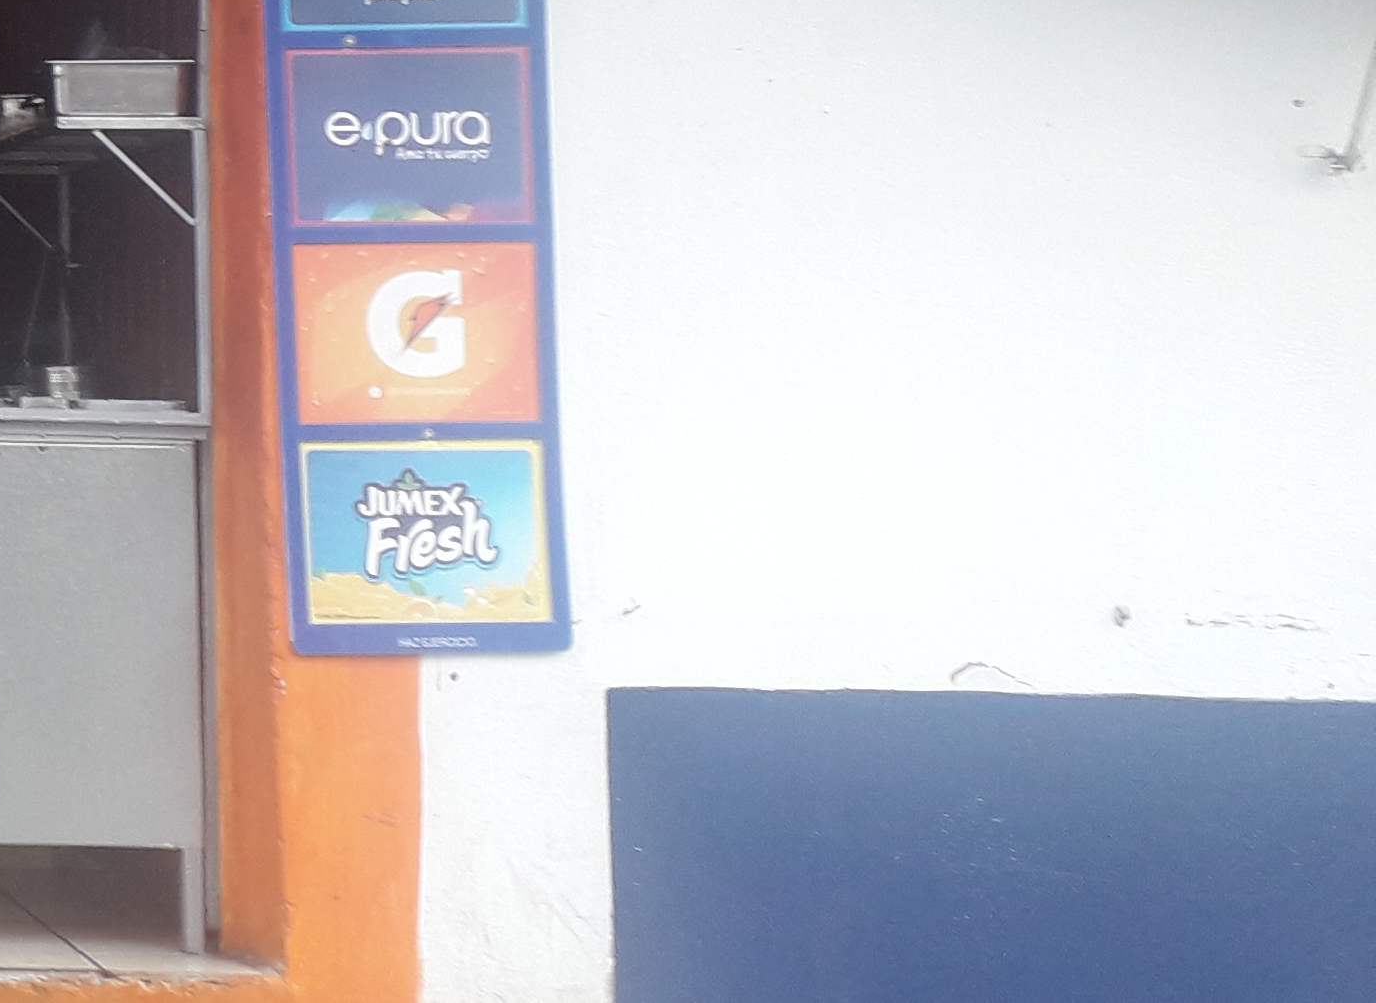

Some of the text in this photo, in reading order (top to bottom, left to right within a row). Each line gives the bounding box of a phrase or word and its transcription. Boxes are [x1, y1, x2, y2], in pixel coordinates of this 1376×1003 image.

[365, 268, 467, 379] G
[356, 485, 465, 517] JUMEX
[364, 499, 499, 579] Fresh
